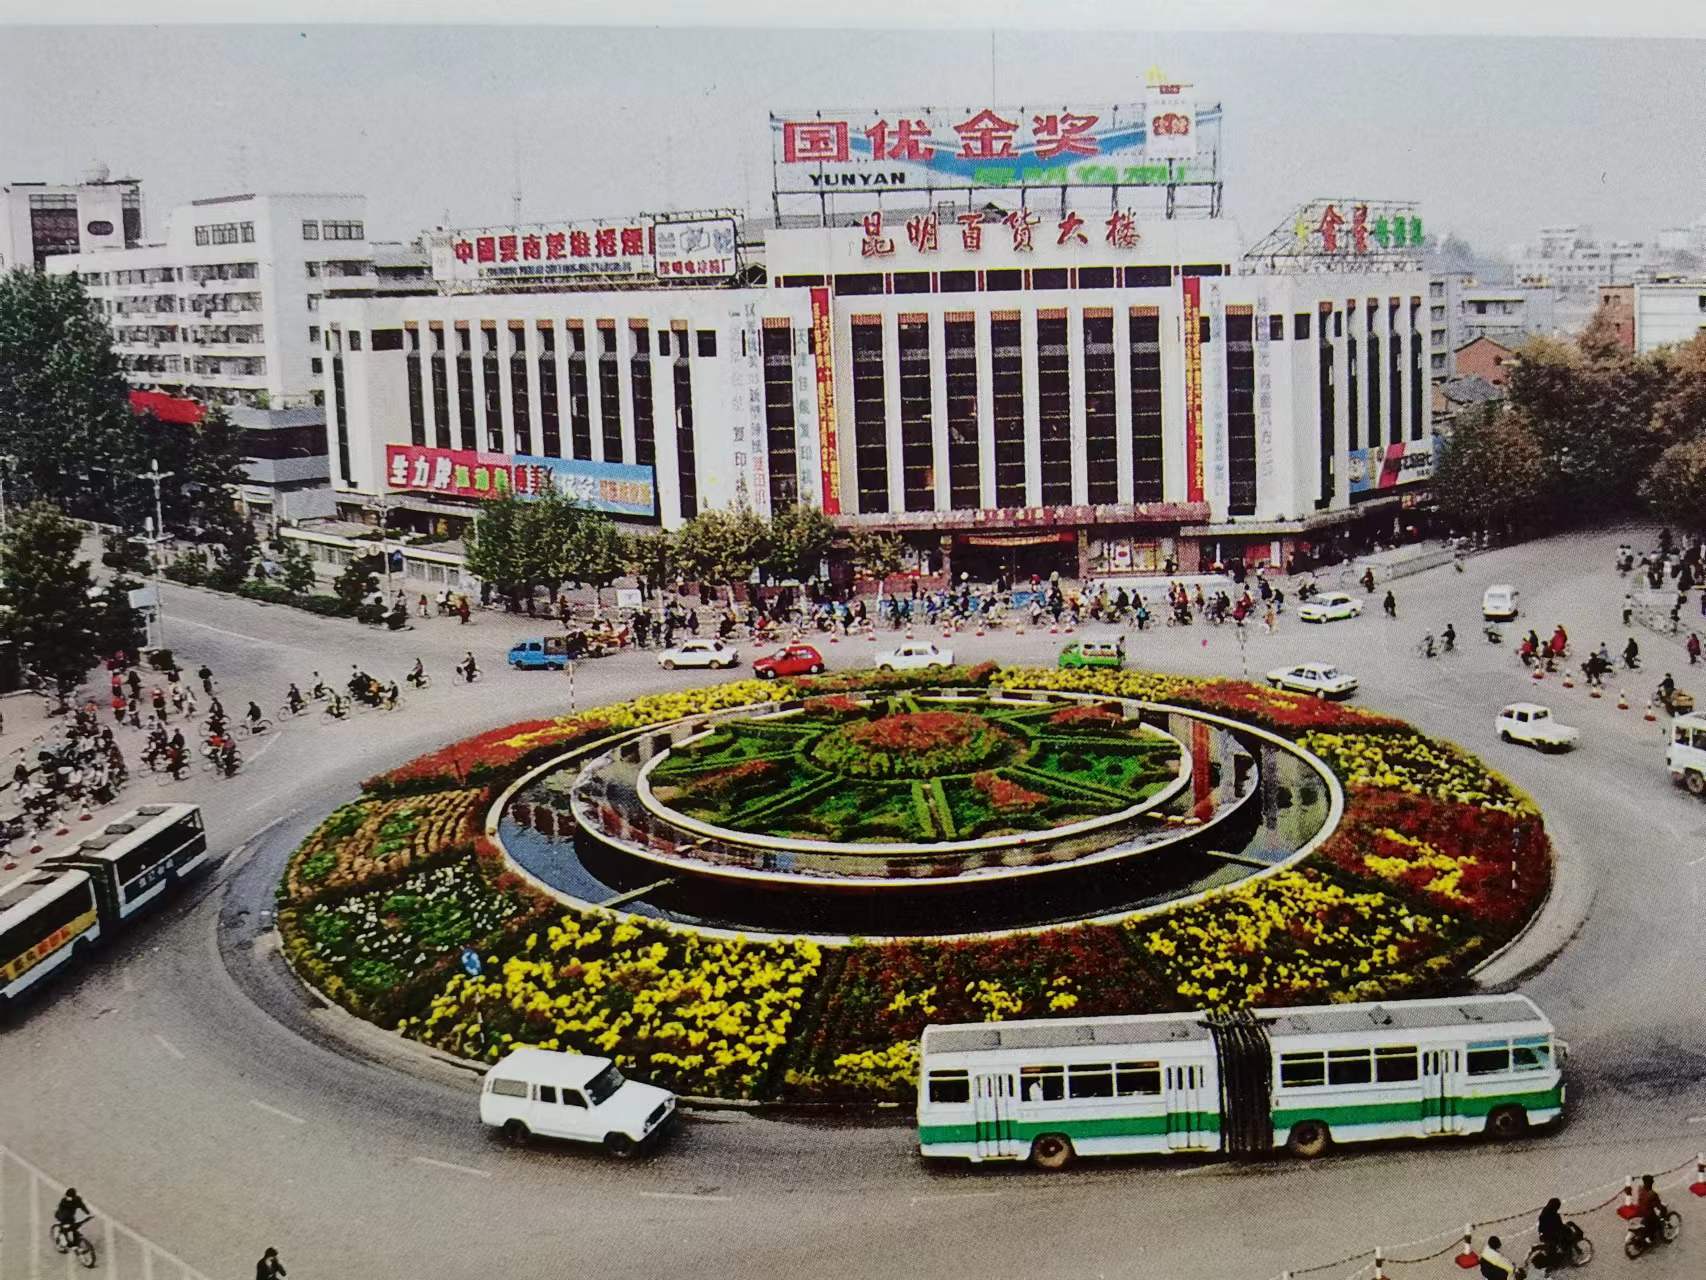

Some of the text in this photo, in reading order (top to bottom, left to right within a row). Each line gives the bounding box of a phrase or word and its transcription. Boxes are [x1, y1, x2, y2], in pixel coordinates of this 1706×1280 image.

[784, 108, 1100, 162] 国优金奖
[809, 172, 906, 186] YUNYAN
[861, 206, 1142, 257] 昆明百货大楼
